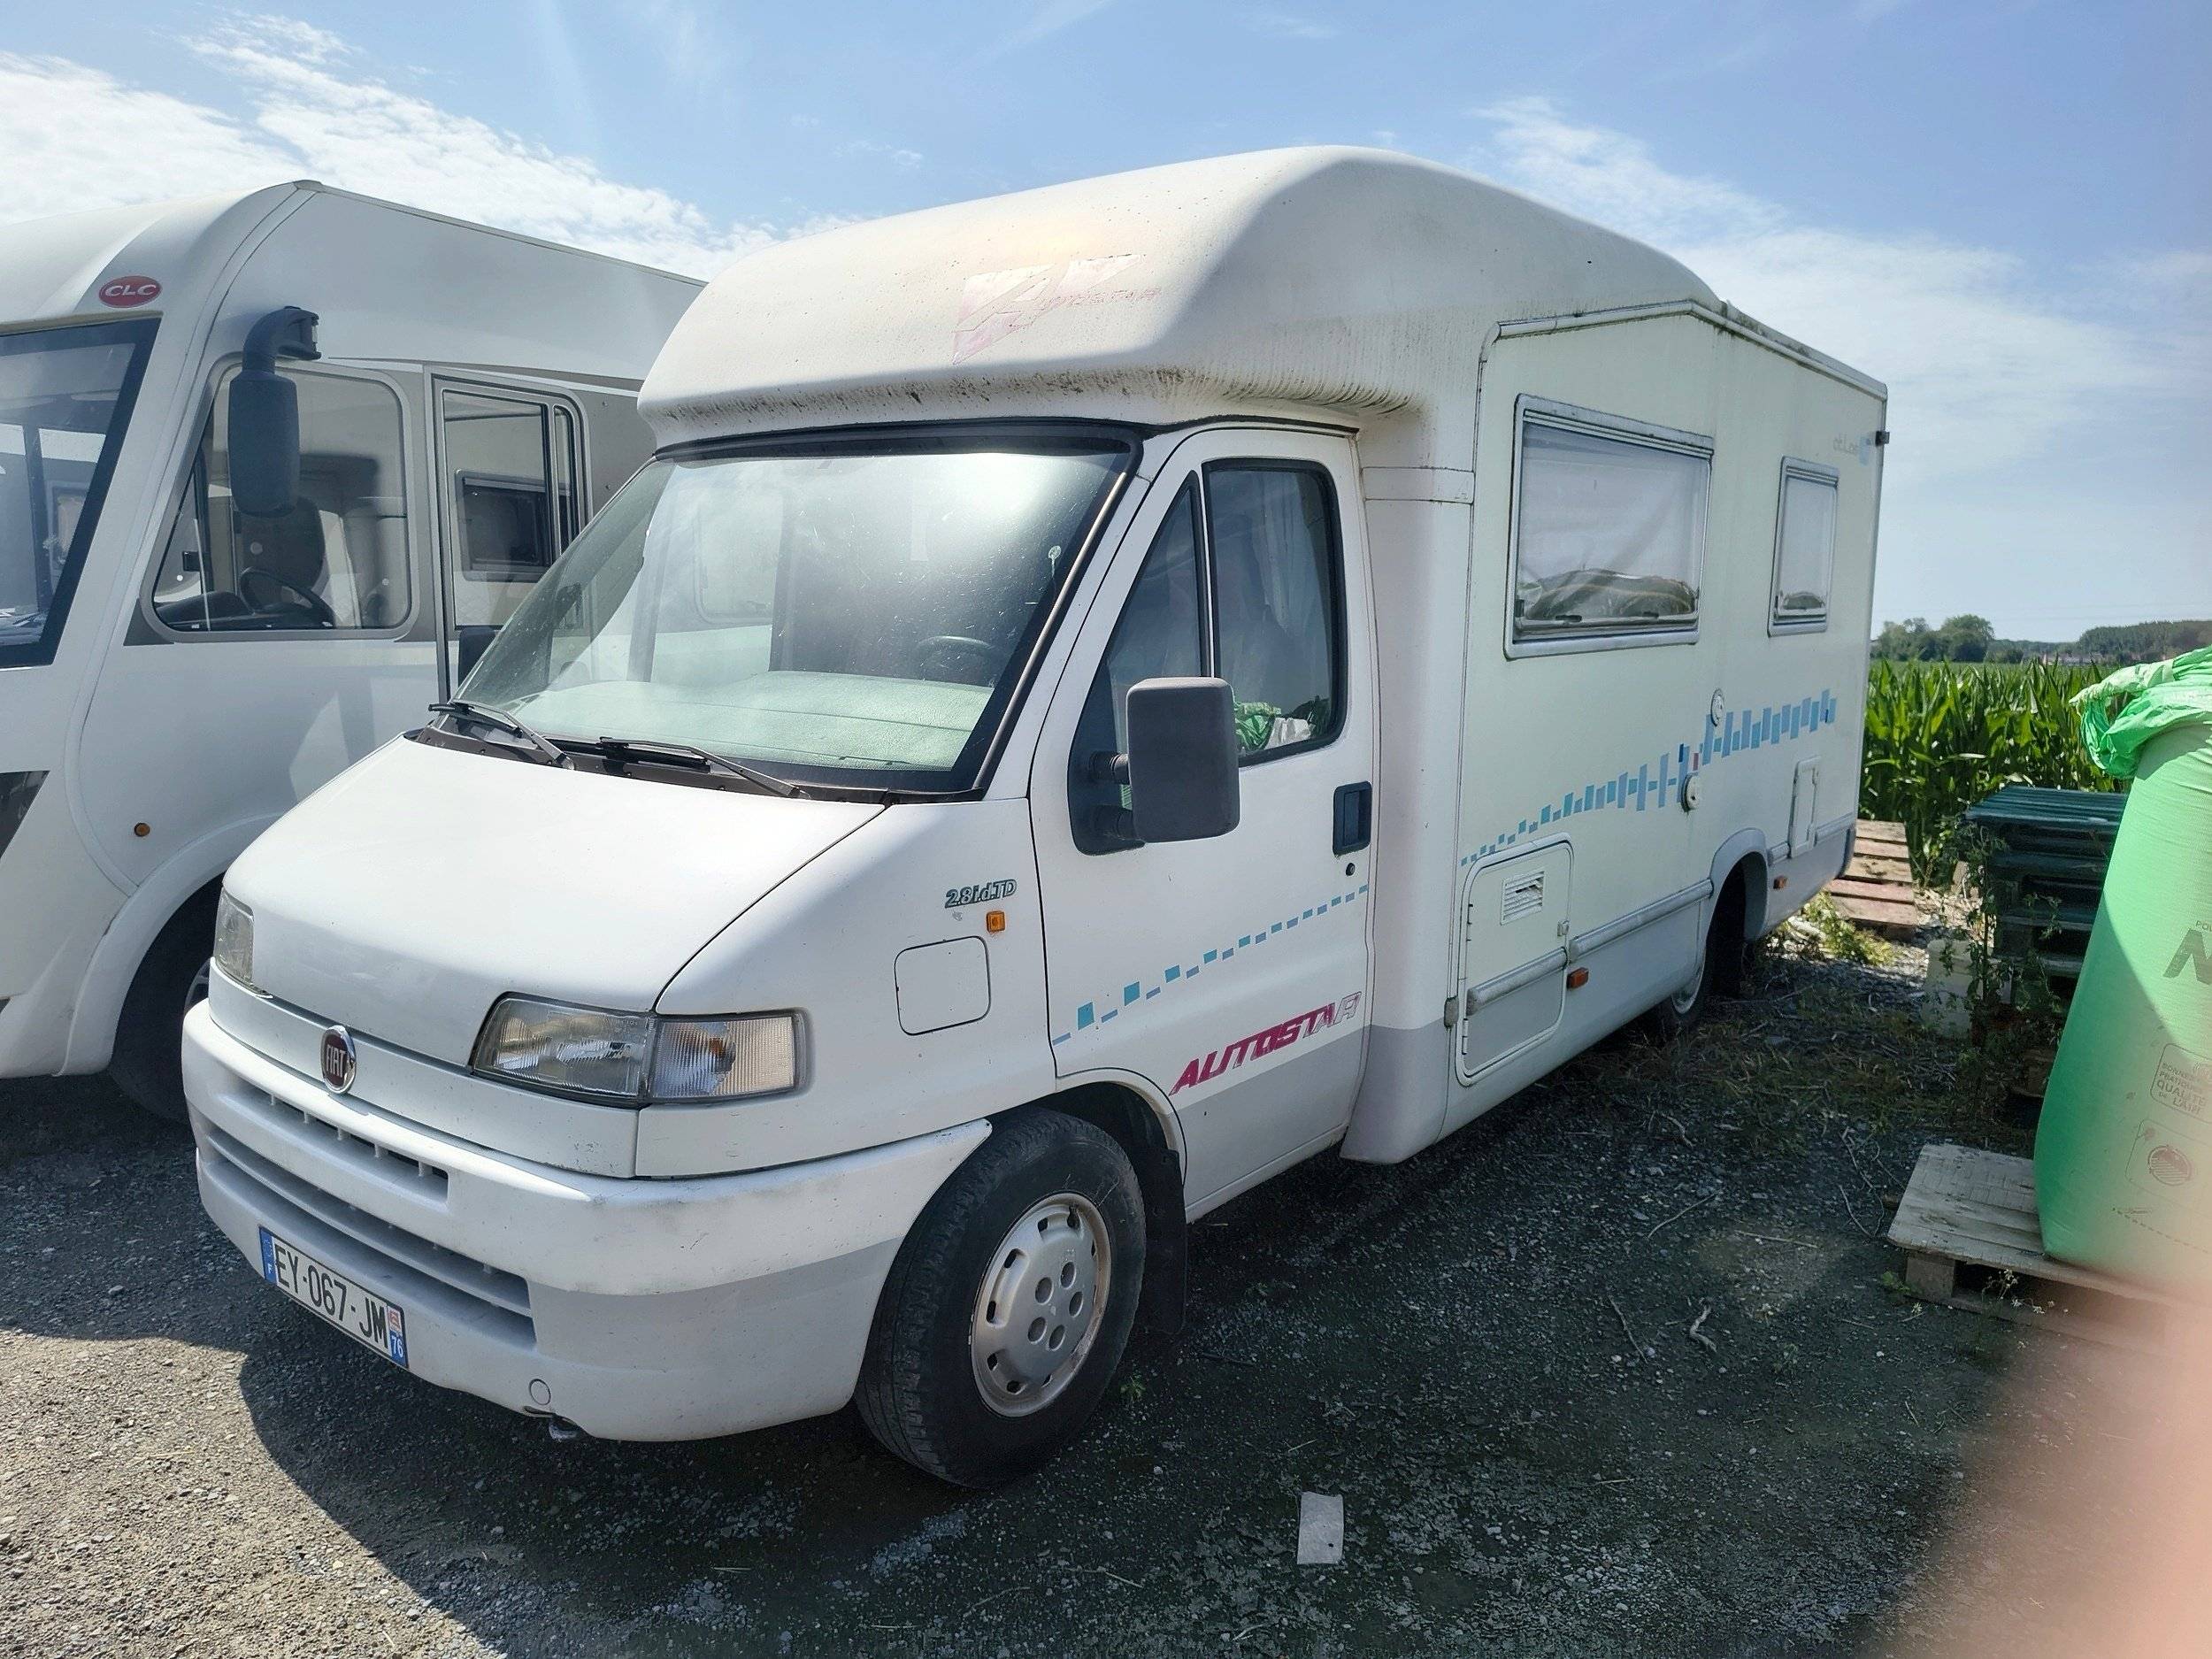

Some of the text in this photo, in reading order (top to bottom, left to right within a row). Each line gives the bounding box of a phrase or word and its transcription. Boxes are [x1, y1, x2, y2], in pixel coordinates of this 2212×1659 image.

[105, 284, 157, 296] CLC
[326, 1043, 346, 1078] FIAT
[1169, 991, 1362, 1096] AUTOSTAR
[274, 1244, 388, 1348] EY-067-JM
[391, 1335, 403, 1357] 76
